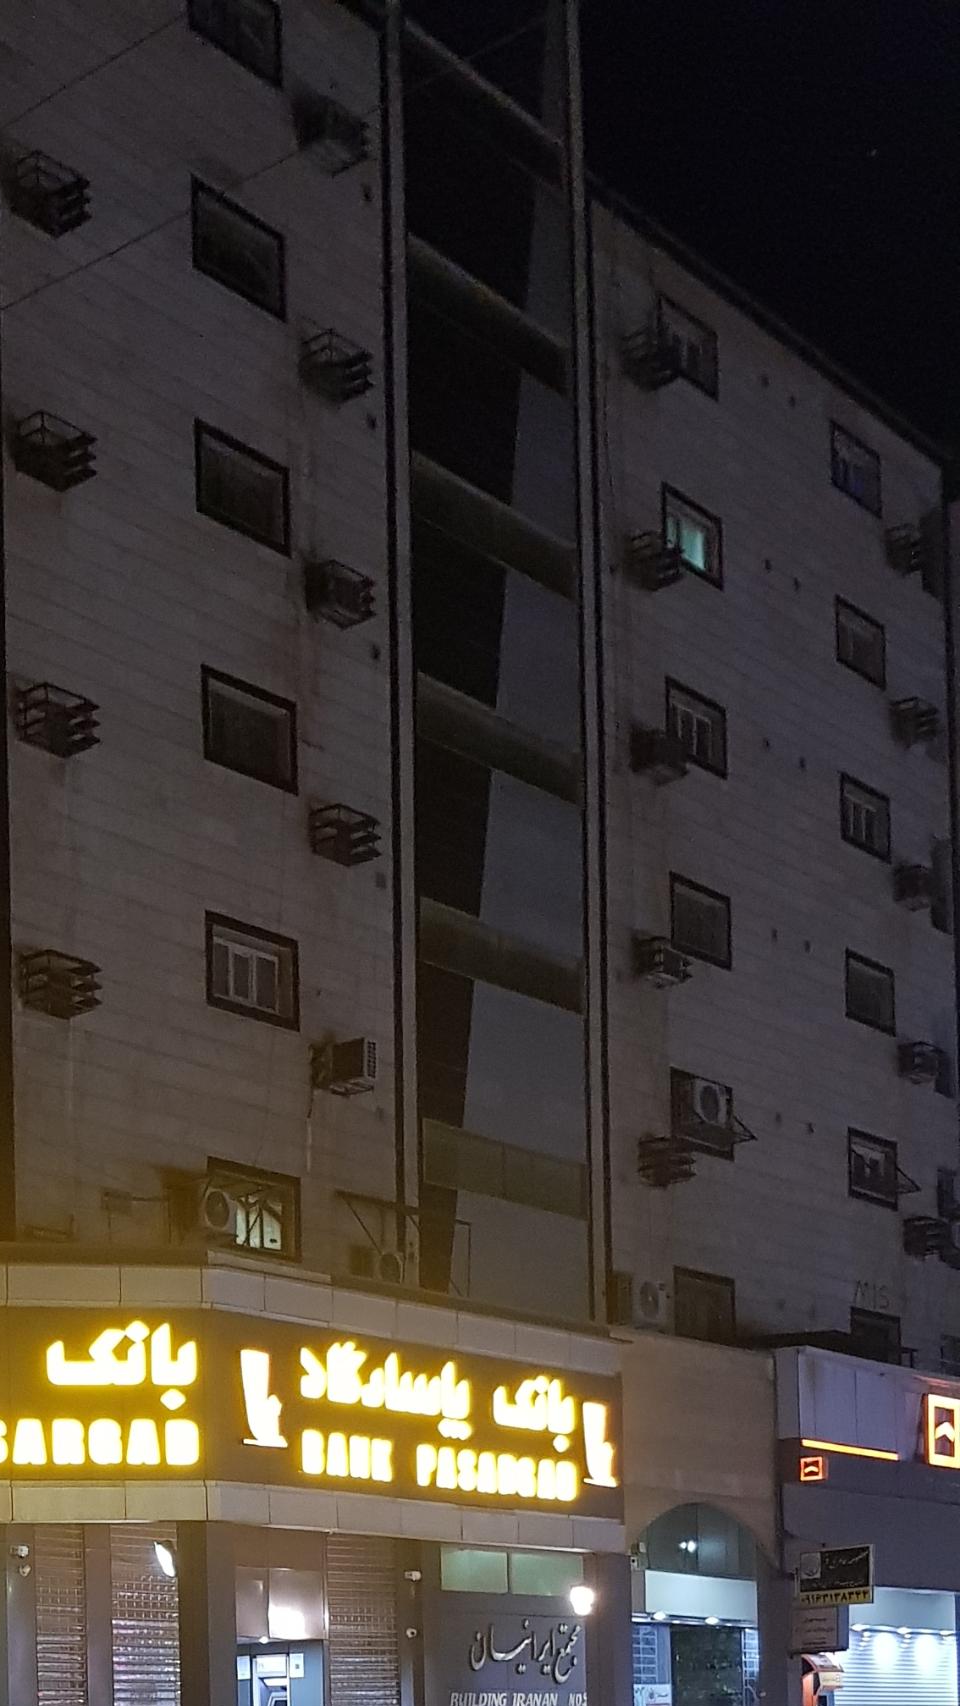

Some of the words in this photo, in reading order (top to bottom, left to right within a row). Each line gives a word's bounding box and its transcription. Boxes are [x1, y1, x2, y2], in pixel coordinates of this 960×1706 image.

[46, 1320, 198, 1411] بانک
[300, 1341, 473, 1440] پاسارگاد
[492, 1375, 575, 1453] بانک
[301, 1428, 393, 1483] BANK
[416, 1443, 577, 1502] PASARGAD
[470, 1619, 555, 1675] ایرانیان
